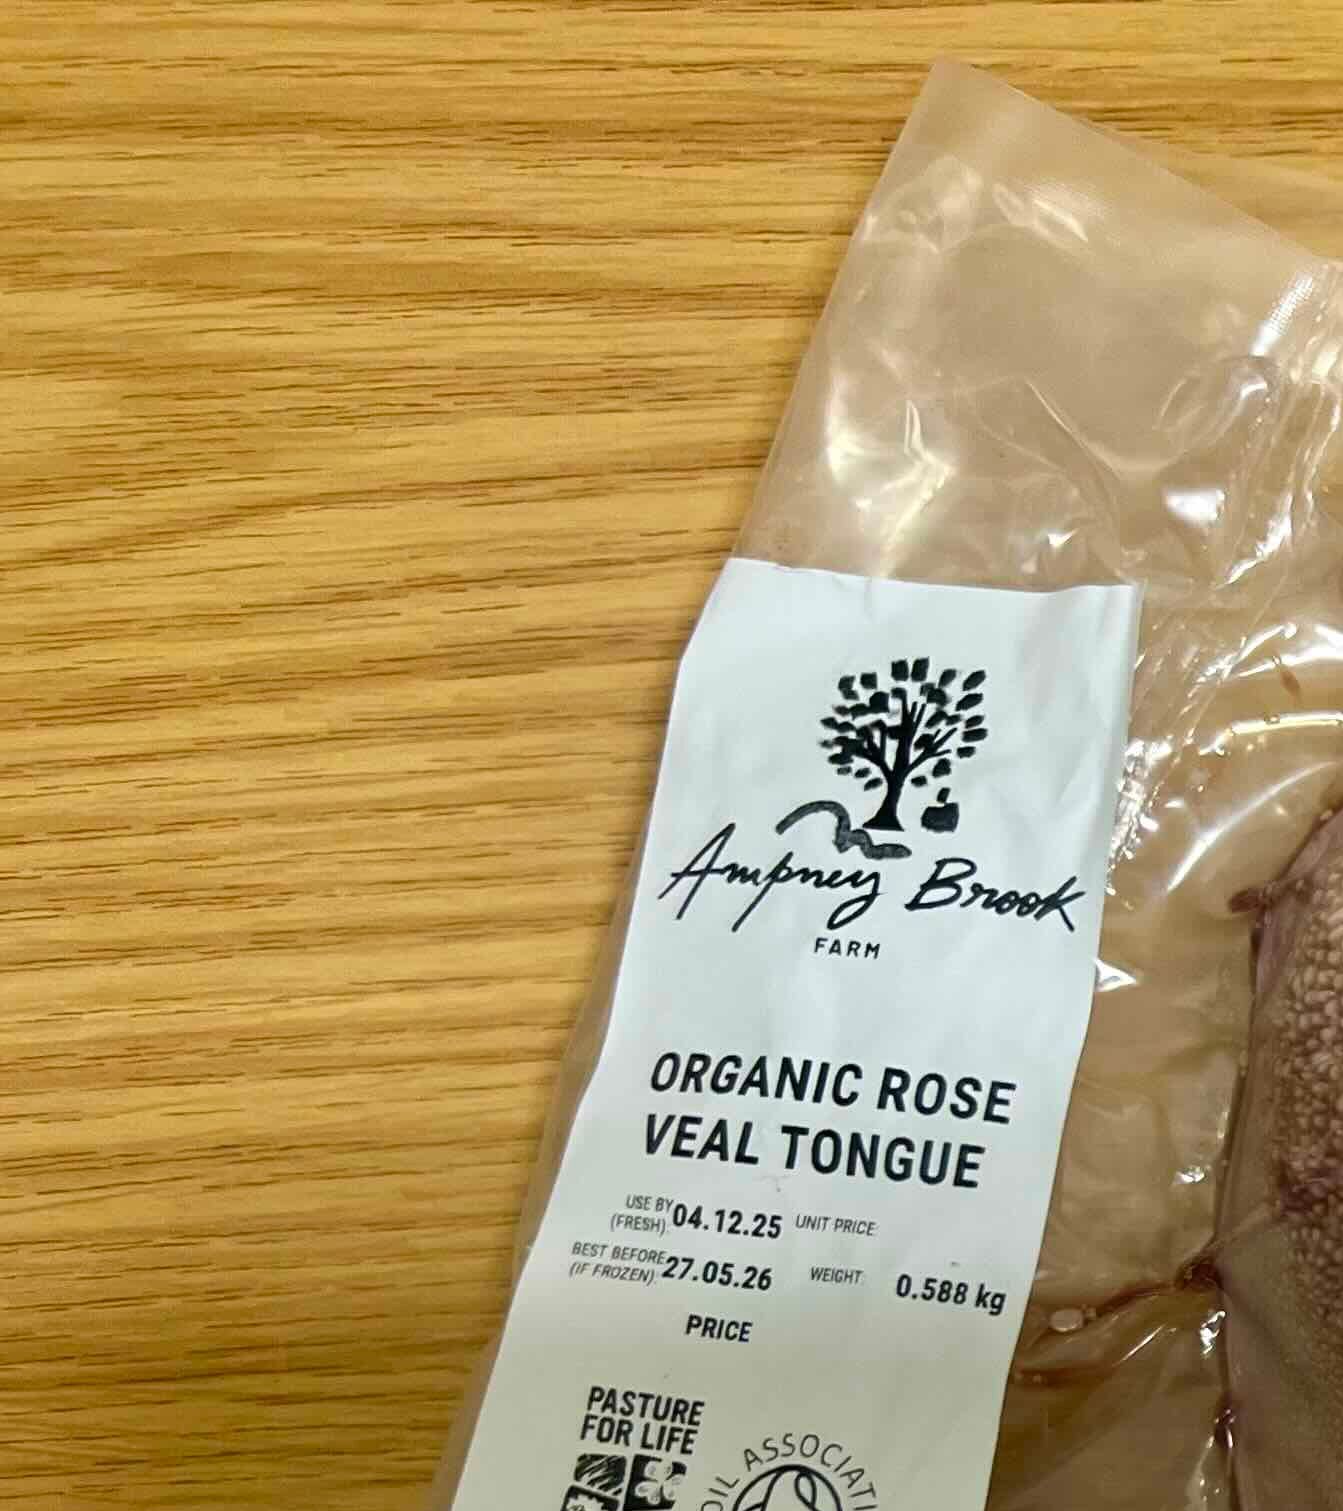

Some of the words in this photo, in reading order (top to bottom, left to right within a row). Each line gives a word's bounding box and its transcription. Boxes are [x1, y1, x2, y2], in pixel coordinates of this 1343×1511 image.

[658, 823, 887, 933] Ampney
[905, 857, 1086, 933] Brook
[814, 938, 881, 960] FARM
[650, 1052, 863, 1108] ORGANIC
[877, 1067, 1017, 1125] ROSE
[645, 1113, 760, 1165] VEAL
[781, 1125, 986, 1189] TONGUE
[625, 1194, 652, 1211] USE
[655, 1196, 674, 1213] BY
[672, 1203, 783, 1239] 04.12.25
[795, 1213, 831, 1232] UNIT
[569, 1261, 591, 1279] (IF
[571, 1241, 608, 1258] BEST
[611, 1245, 667, 1266] BEFORE
[661, 1255, 773, 1291] 27.05.26
[896, 1273, 969, 1305] 0.588
[974, 1283, 1007, 1316] kg
[685, 1313, 753, 1343] PRICE
[586, 1385, 705, 1427] PASTURE
[580, 1415, 633, 1448] FOR
[641, 1423, 699, 1456] LIFE
